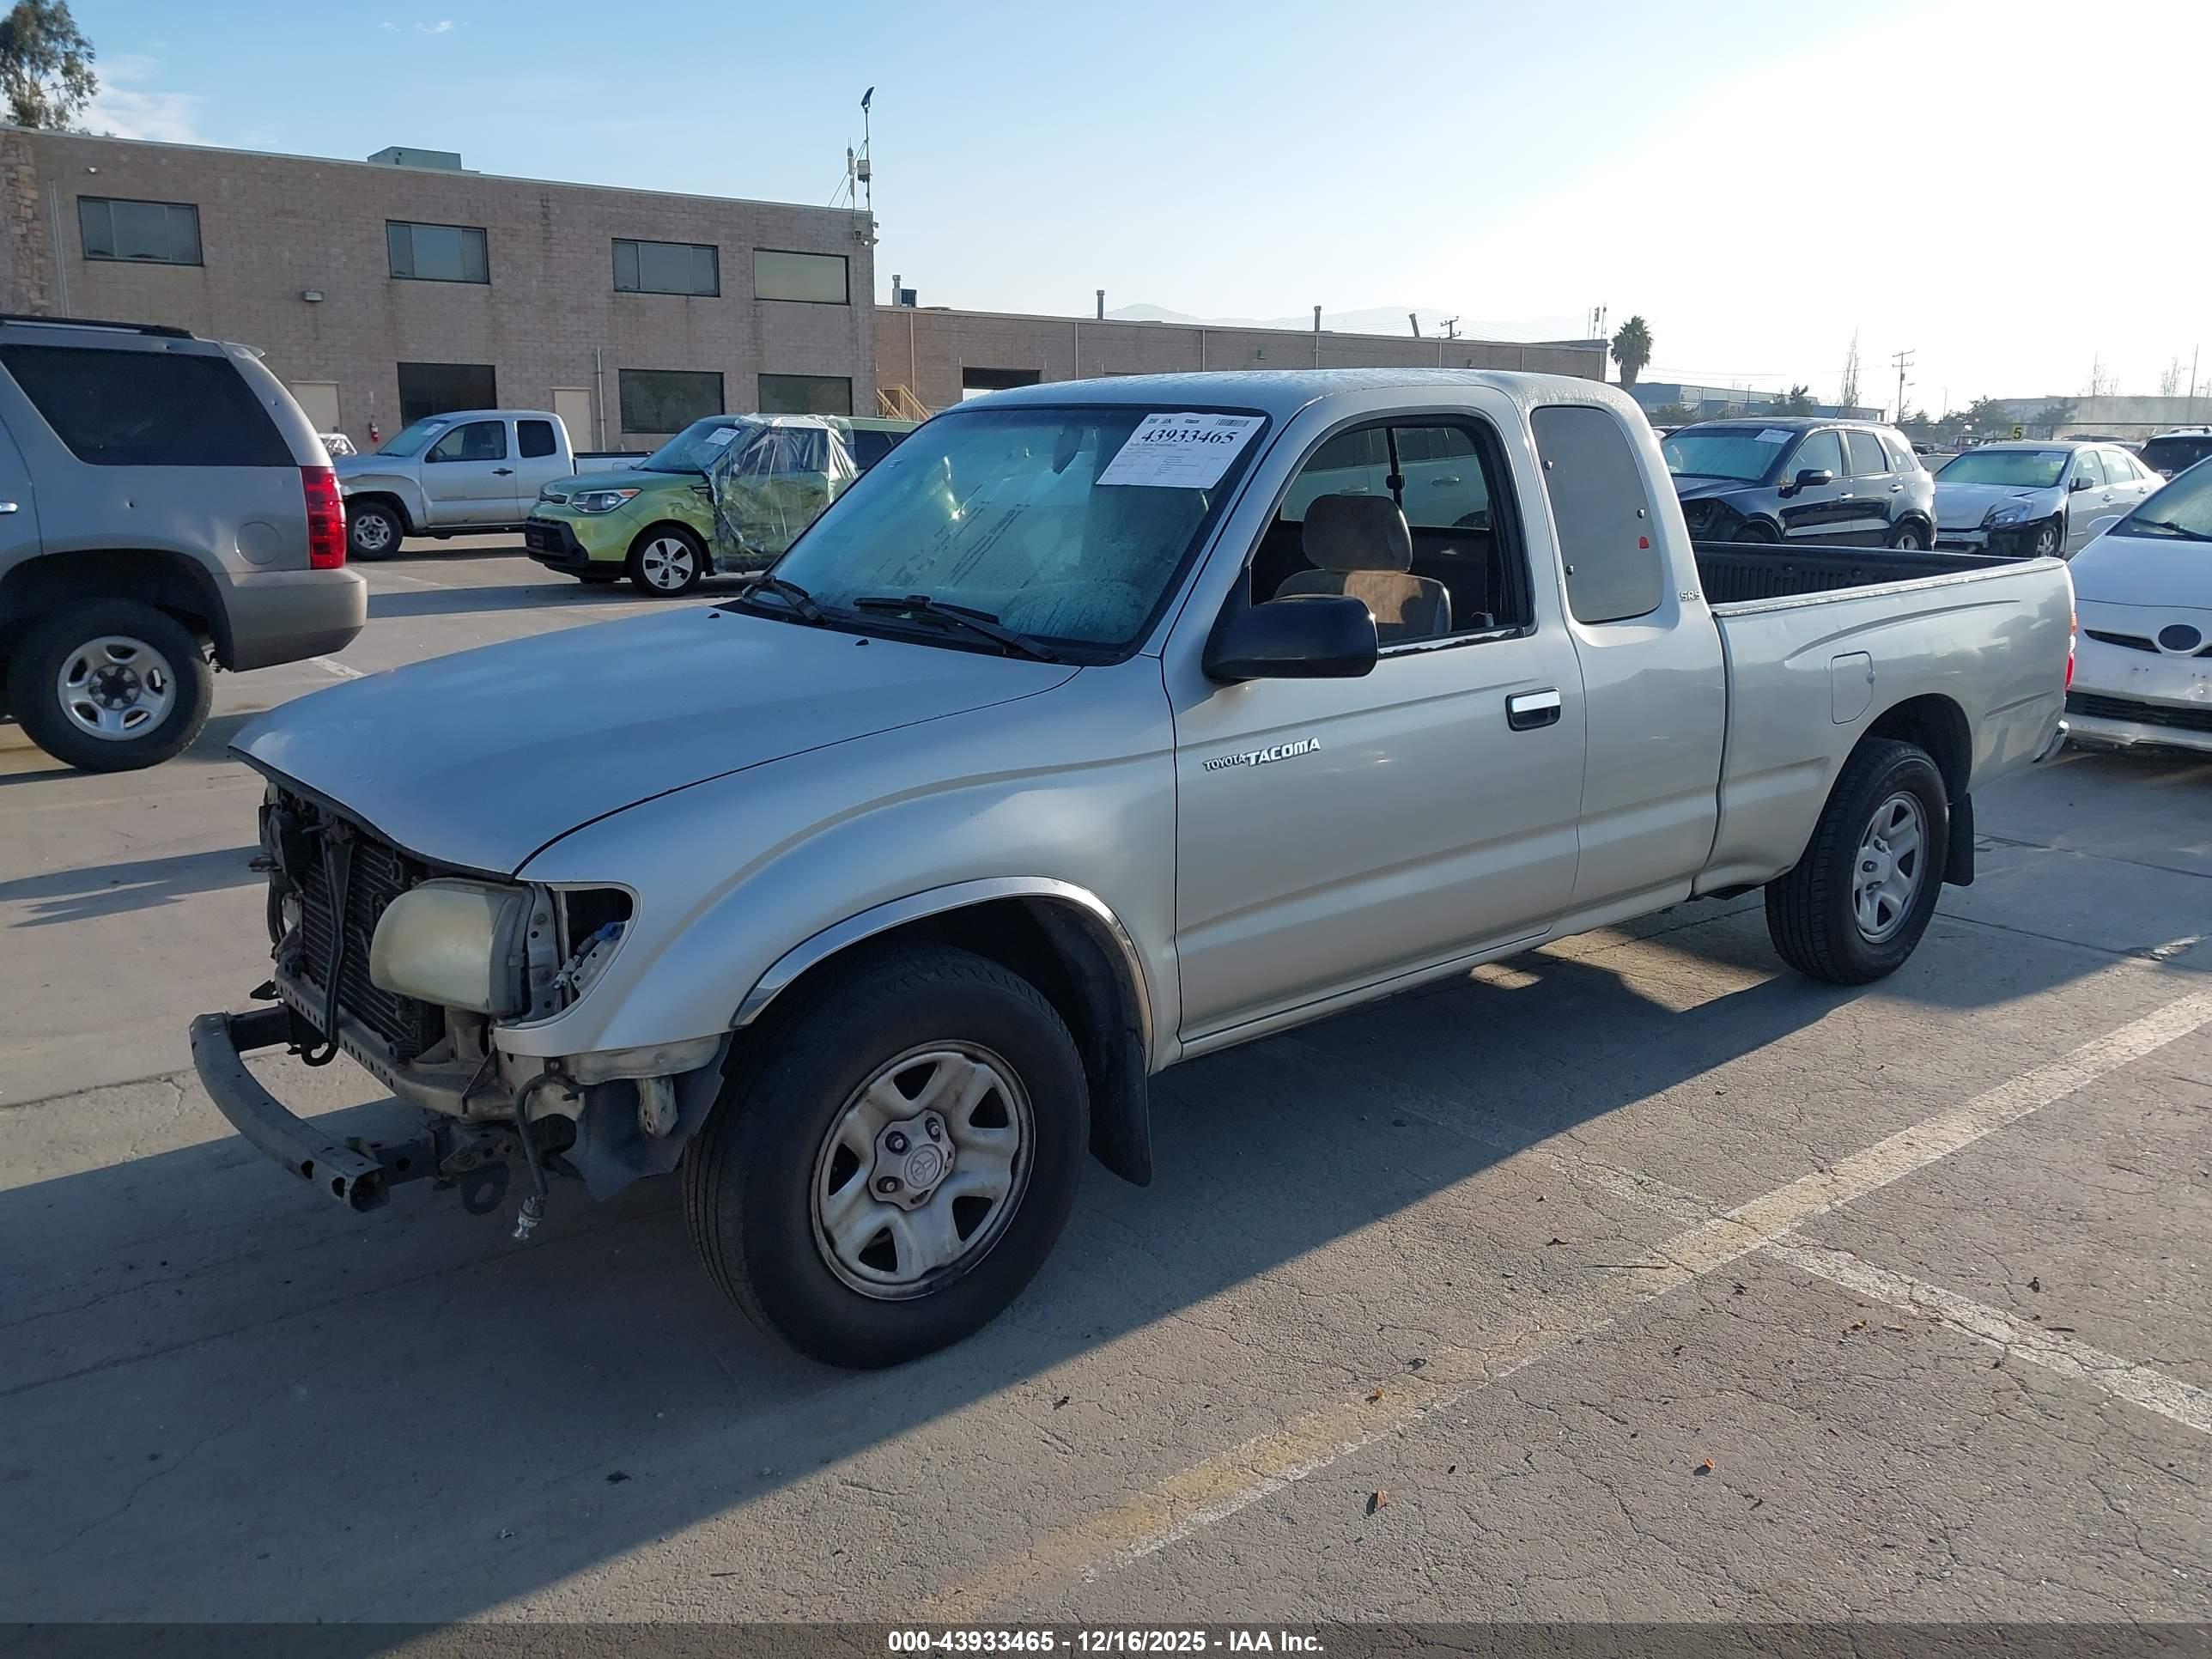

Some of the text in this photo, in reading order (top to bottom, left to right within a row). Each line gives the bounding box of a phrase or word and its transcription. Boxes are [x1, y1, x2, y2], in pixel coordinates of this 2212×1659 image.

[1140, 428, 1239, 445] 43933465
[2013, 427, 2022, 440] 5
[1203, 737, 1321, 771] TOYOTA TACOMA
